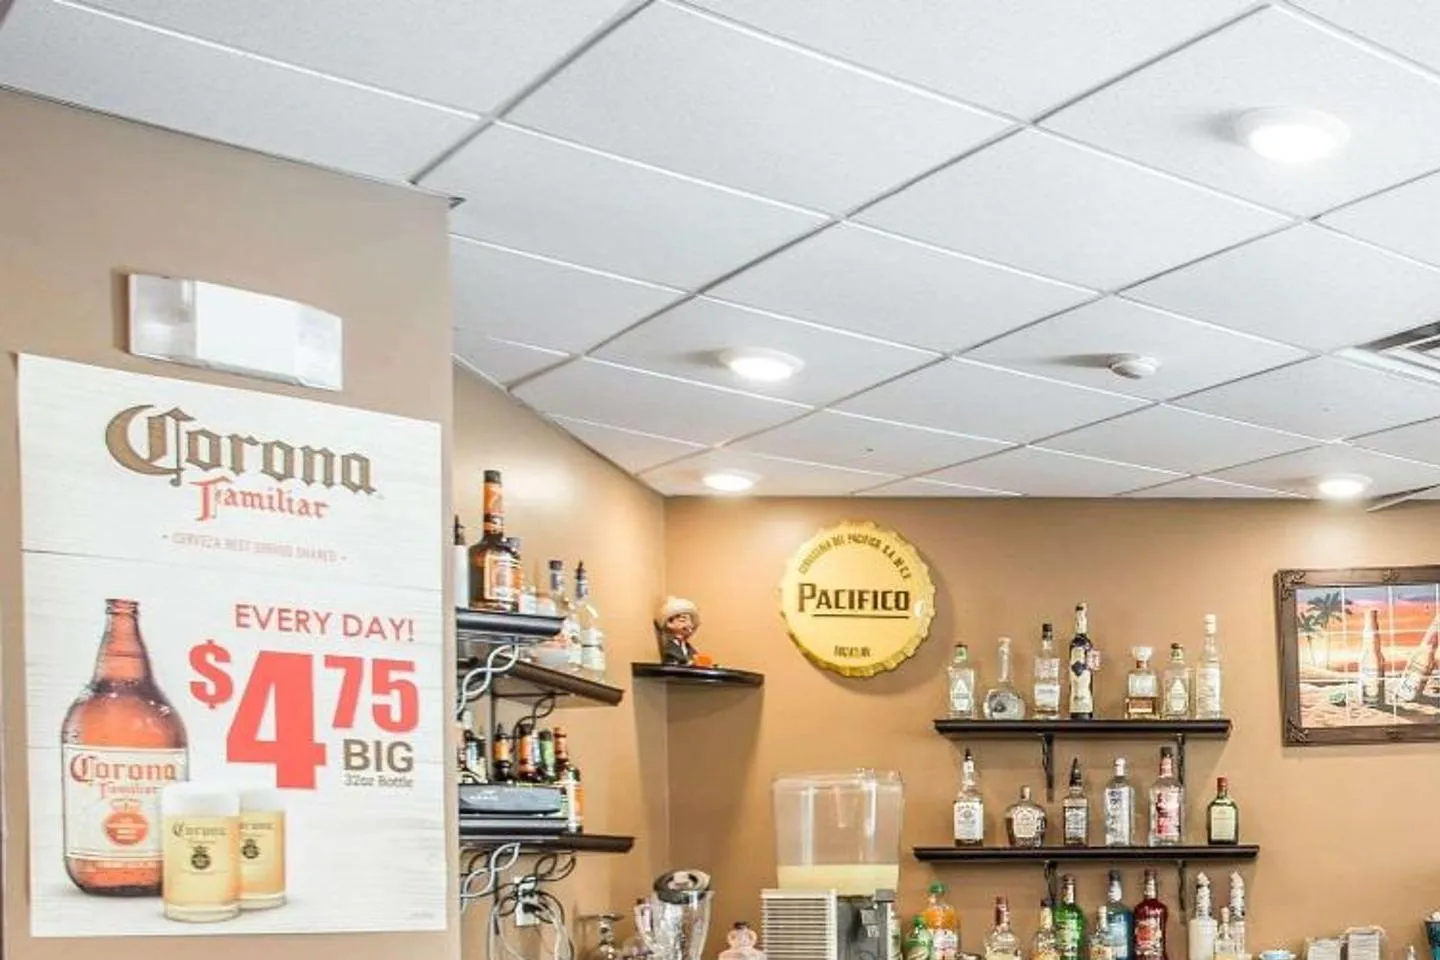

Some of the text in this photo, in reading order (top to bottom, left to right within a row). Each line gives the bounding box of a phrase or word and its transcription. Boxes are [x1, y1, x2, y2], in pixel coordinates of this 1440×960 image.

[105, 404, 378, 494] Corona
[189, 476, 330, 521] Familiar
[798, 583, 910, 612] PACIFICO
[235, 604, 415, 643] EVERY DAY!
[70, 752, 178, 786] Corona
[343, 738, 414, 773] BIG
[378, 775, 414, 788] Bottle
